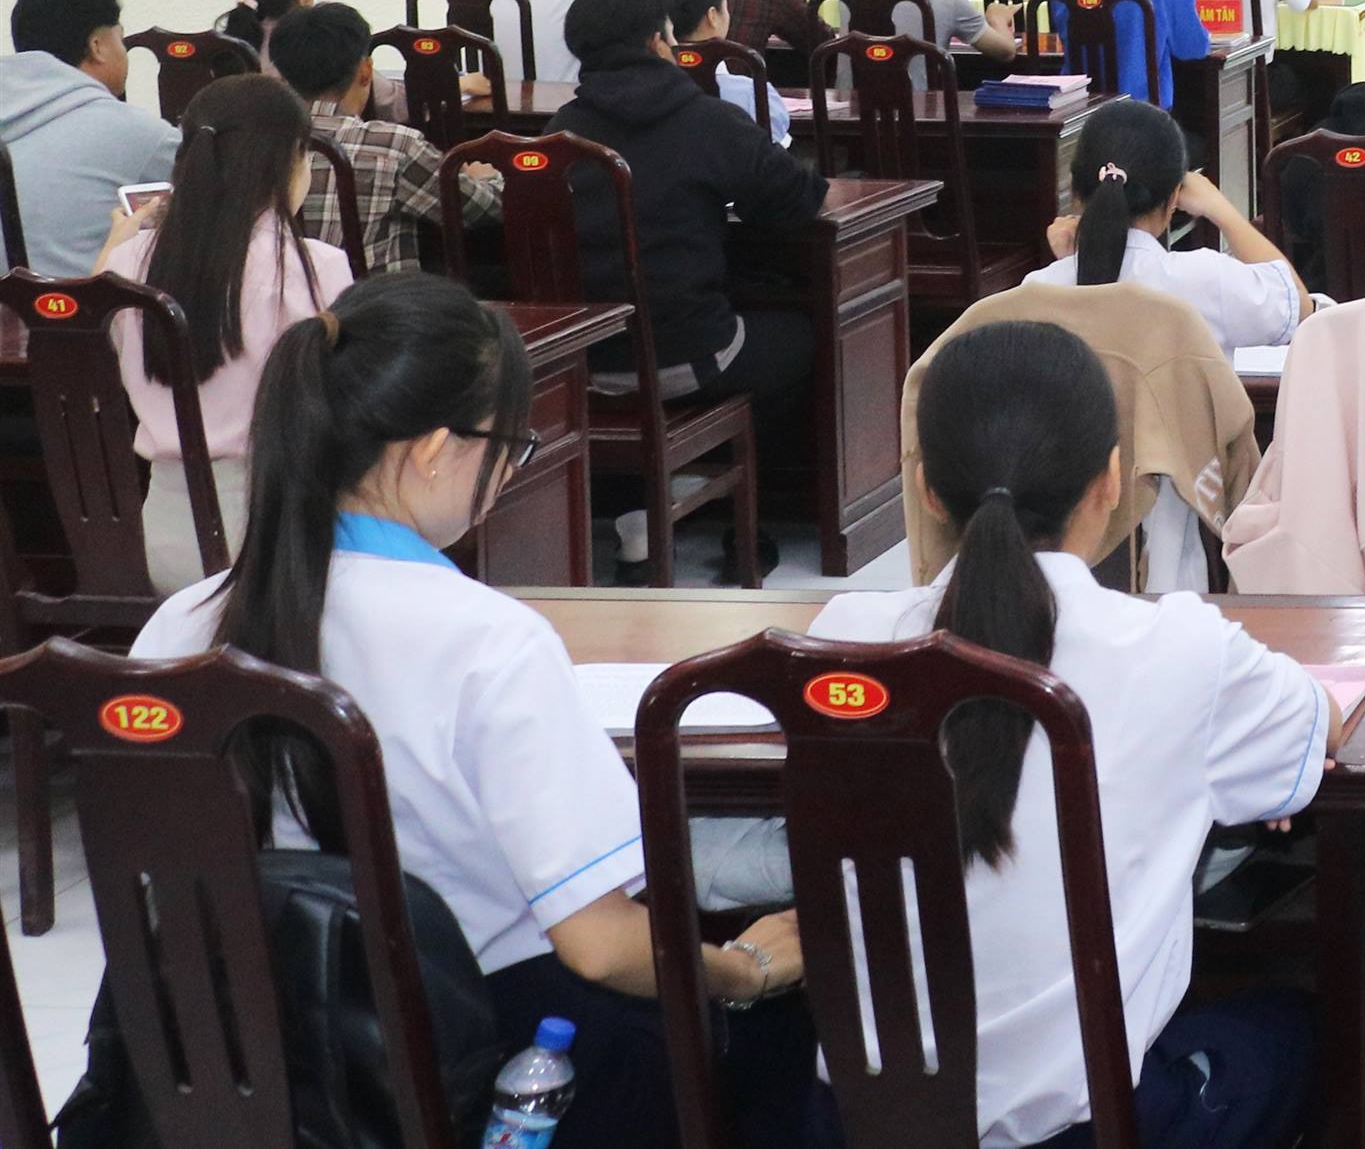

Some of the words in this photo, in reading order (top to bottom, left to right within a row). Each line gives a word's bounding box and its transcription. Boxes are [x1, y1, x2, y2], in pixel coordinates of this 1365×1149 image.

[1345, 151, 1361, 163] 42
[48, 299, 65, 312] 41
[829, 682, 865, 707] 53
[115, 705, 169, 730] 122
